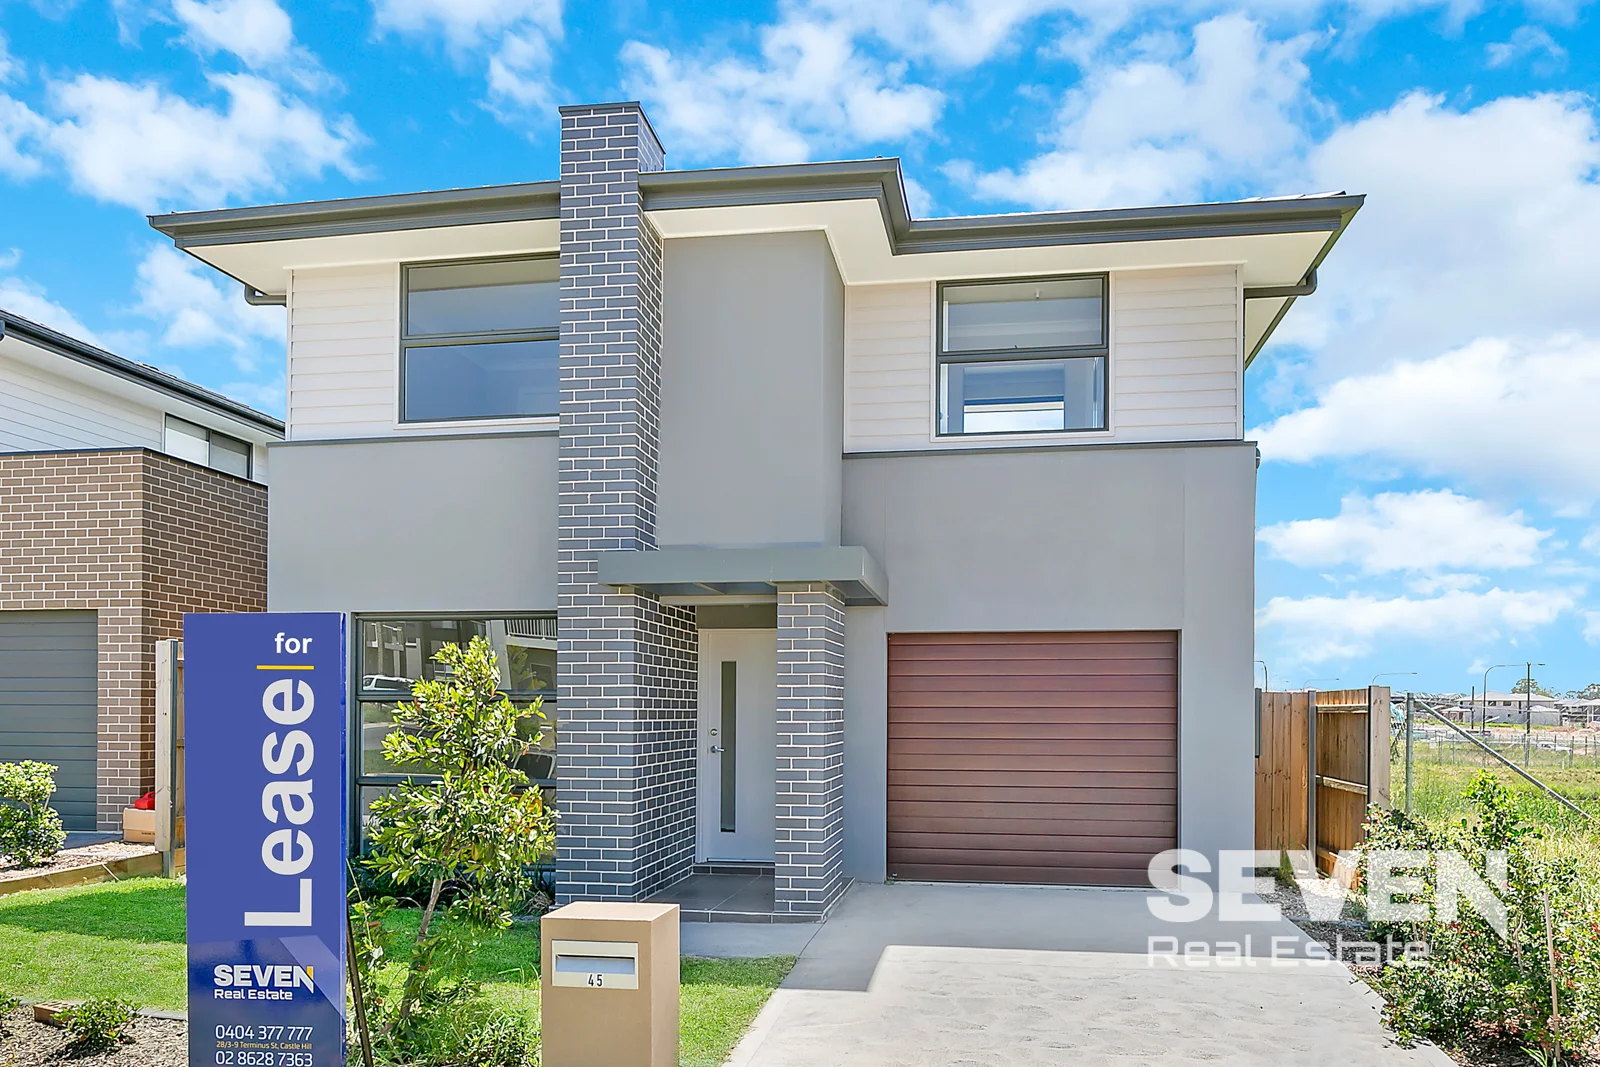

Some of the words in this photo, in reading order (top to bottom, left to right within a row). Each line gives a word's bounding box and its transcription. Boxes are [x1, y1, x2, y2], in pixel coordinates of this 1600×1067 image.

[274, 632, 313, 654] for
[244, 678, 315, 927] Lease
[214, 964, 314, 994] SEVEN
[588, 974, 603, 986] 45
[214, 989, 245, 999] Real
[248, 989, 293, 1000] Estate
[215, 1024, 255, 1040] 0404
[258, 1025, 284, 1040] 377
[287, 1026, 314, 1041] 777
[216, 1040, 239, 1049] 28/3-9
[239, 1041, 270, 1050] Terminus
[280, 1042, 301, 1050] Castle
[215, 1050, 234, 1065] 02
[237, 1051, 274, 1066] 8628
[277, 1052, 313, 1067] 7363
